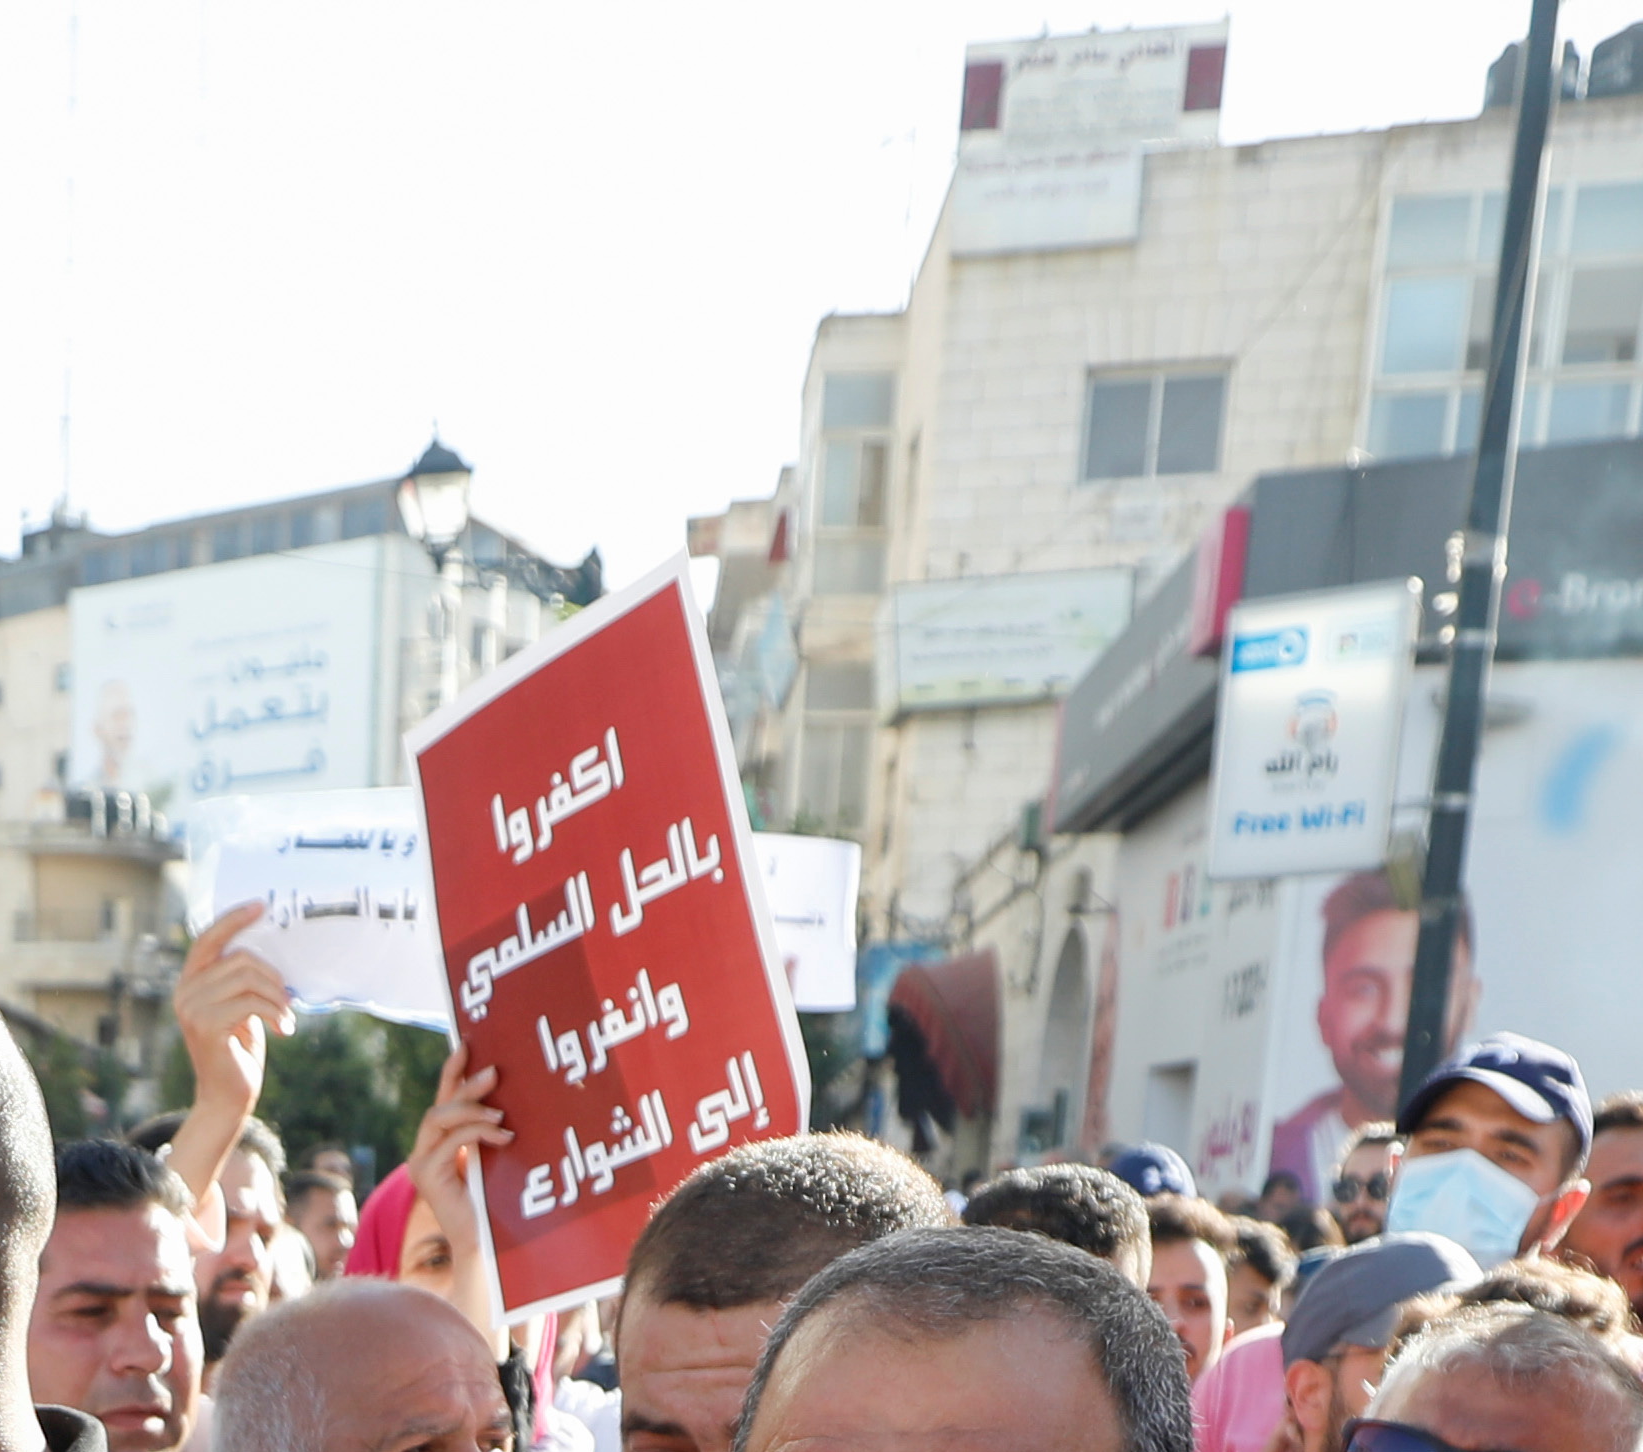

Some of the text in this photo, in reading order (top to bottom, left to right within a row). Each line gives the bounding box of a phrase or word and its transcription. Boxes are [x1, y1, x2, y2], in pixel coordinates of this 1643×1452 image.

[491, 726, 625, 865] اكفروا
[459, 816, 724, 1023] بالحل السلمي
[536, 967, 690, 1085] وانفروا
[520, 1049, 771, 1219] إلى الشوارع
